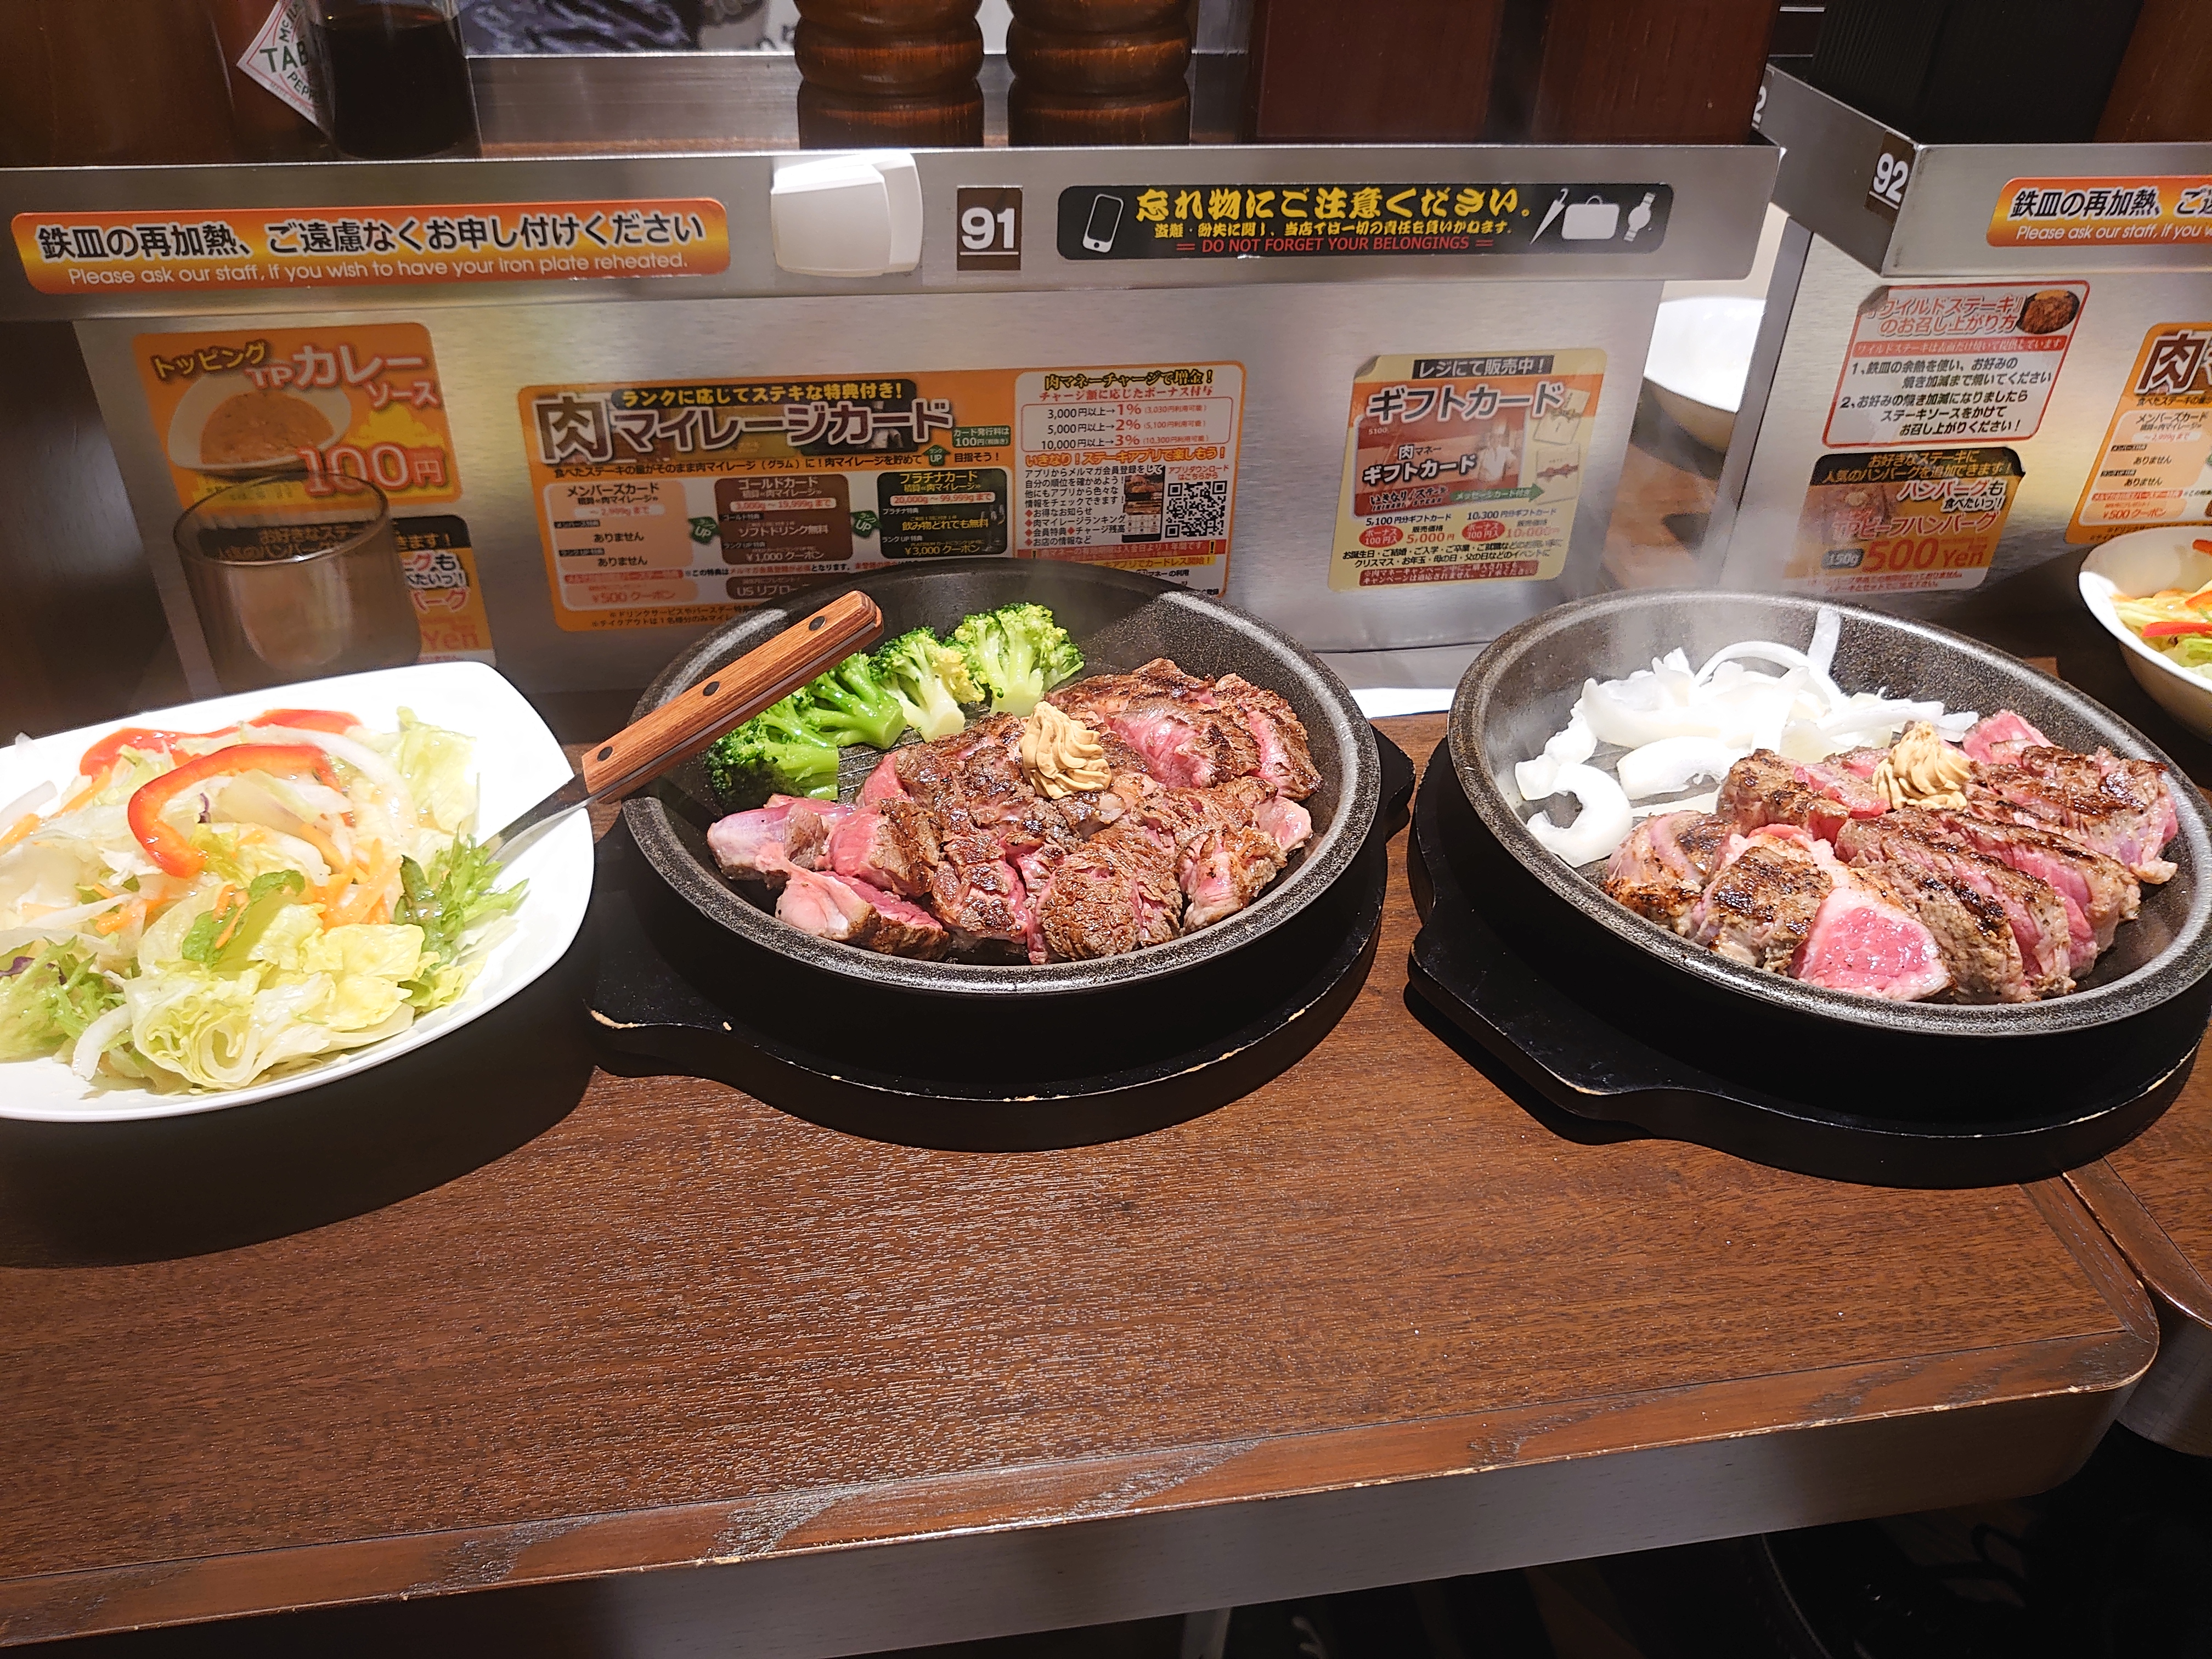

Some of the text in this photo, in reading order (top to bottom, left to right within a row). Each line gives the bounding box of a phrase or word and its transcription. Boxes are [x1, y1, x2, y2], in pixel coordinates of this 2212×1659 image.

[1872, 153, 1909, 204] 92
[1136, 187, 1531, 221] 忘れ物にご注意ください。
[961, 207, 1015, 250] 91
[2016, 225, 2063, 240] Please
[2068, 225, 2091, 239] ask
[2095, 227, 2118, 238] our
[2121, 224, 2158, 239] staff,
[2173, 226, 2200, 240] you
[1202, 235, 1470, 253] DO NOT FORGET YOUR BELONGINGS
[69, 267, 135, 285] Please
[140, 267, 172, 283] ask
[178, 269, 211, 283] our
[215, 263, 264, 283] staff,
[283, 265, 321, 281] you
[326, 261, 368, 279] wish
[373, 261, 393, 277] to
[398, 257, 448, 276] have
[452, 260, 493, 278] your
[540, 254, 588, 275] plate
[594, 252, 689, 270] reheated.
[1878, 312, 2019, 337] のお召し上がり方
[153, 340, 267, 379] トッピング
[245, 344, 425, 390] TPカレー
[1420, 357, 1545, 379] レジにて販売中！
[1045, 369, 1214, 391] 肉マネーチャージで増金！
[367, 380, 439, 407] ソース
[1369, 382, 1563, 421] ギフトカード
[1116, 404, 1142, 415] 1%
[1881, 405, 2007, 422] ステーキソースをかけて
[535, 393, 953, 464] 肉マイレージカード
[1115, 419, 1141, 431] 2%
[1115, 435, 1140, 447] 3%
[930, 453, 942, 463] UP
[1398, 443, 1442, 460] 肉マネー
[1868, 450, 1980, 467] お好きなステーキに
[2132, 455, 2172, 465] ありません
[297, 442, 445, 496] 100円
[1168, 464, 1229, 474] アプリダウンロード
[1363, 454, 1477, 485] ギフトカード
[738, 476, 819, 490] ゴールドカード
[900, 470, 978, 485] プラチナカード
[2124, 477, 2163, 487] ありません
[567, 482, 659, 497] メンバーズカード
[1025, 487, 1119, 499] 他にもアプリから色々な
[1899, 479, 2003, 498] ハンバーグも
[1025, 496, 1124, 509] 情報をチェックできます！
[1033, 507, 1092, 517] お得なお知らせ
[855, 520, 872, 532] UP
[1033, 515, 1125, 527] 肉マイレージランキング
[593, 532, 645, 543] ありません
[694, 527, 712, 537] UP
[1033, 527, 1067, 537] 会員特典
[1365, 527, 1398, 537] ボーナス
[1406, 533, 1455, 544] 5,000円
[1033, 535, 1092, 546] お店の情報など
[942, 543, 981, 554] クーポン
[1863, 537, 1939, 573] 500
[1943, 549, 1985, 567] Yen
[597, 556, 648, 567] ありません
